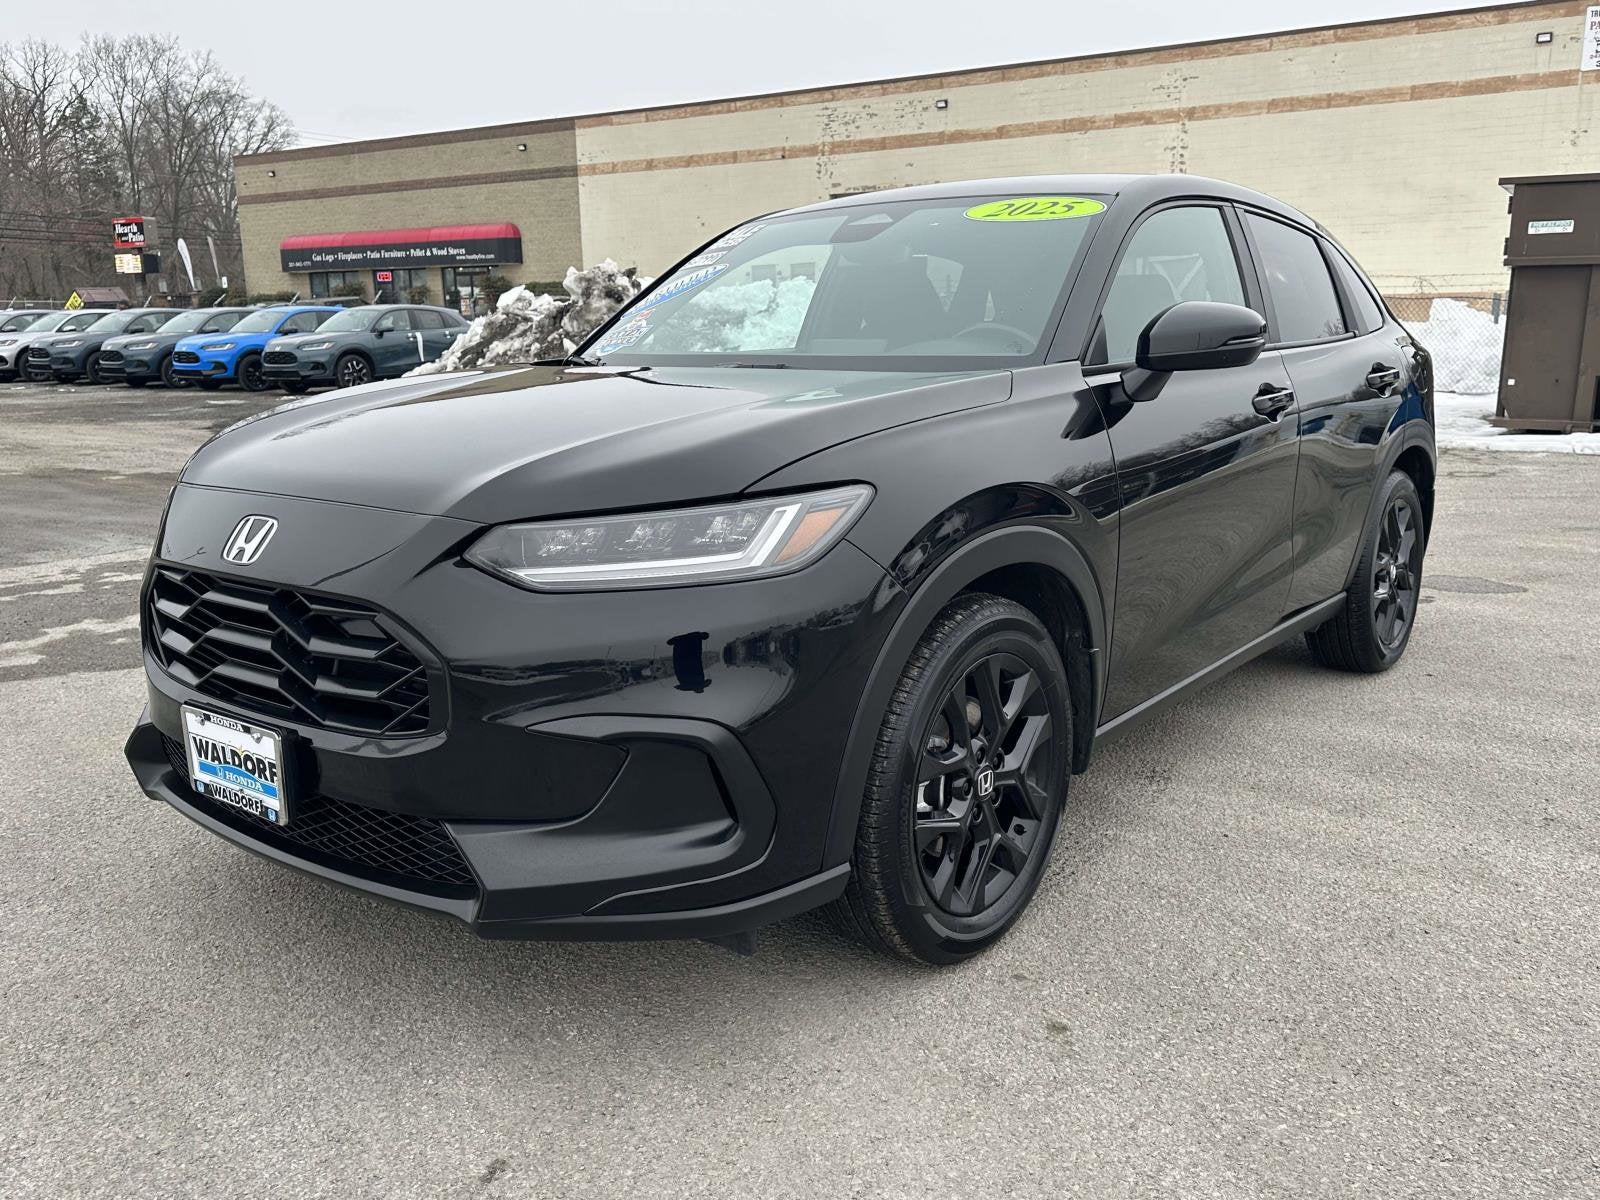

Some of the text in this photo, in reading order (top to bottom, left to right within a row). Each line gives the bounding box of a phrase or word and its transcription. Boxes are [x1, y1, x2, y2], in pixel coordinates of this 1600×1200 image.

[982, 201, 1085, 217] 2025
[115, 223, 138, 234] Hearth
[128, 232, 144, 242] Patio
[312, 253, 322, 261] Gas
[322, 252, 334, 262] Logs
[338, 251, 363, 261] Fireplaces
[367, 250, 380, 259] Patio
[381, 249, 406, 259] Furniture
[410, 248, 425, 257] Pellet
[432, 247, 447, 256] Wood
[448, 246, 465, 255] Stoves
[210, 715, 244, 732] HONDA
[192, 735, 278, 784] WALDORF
[225, 771, 264, 792] HONDA
[210, 783, 263, 814] WALDORF
